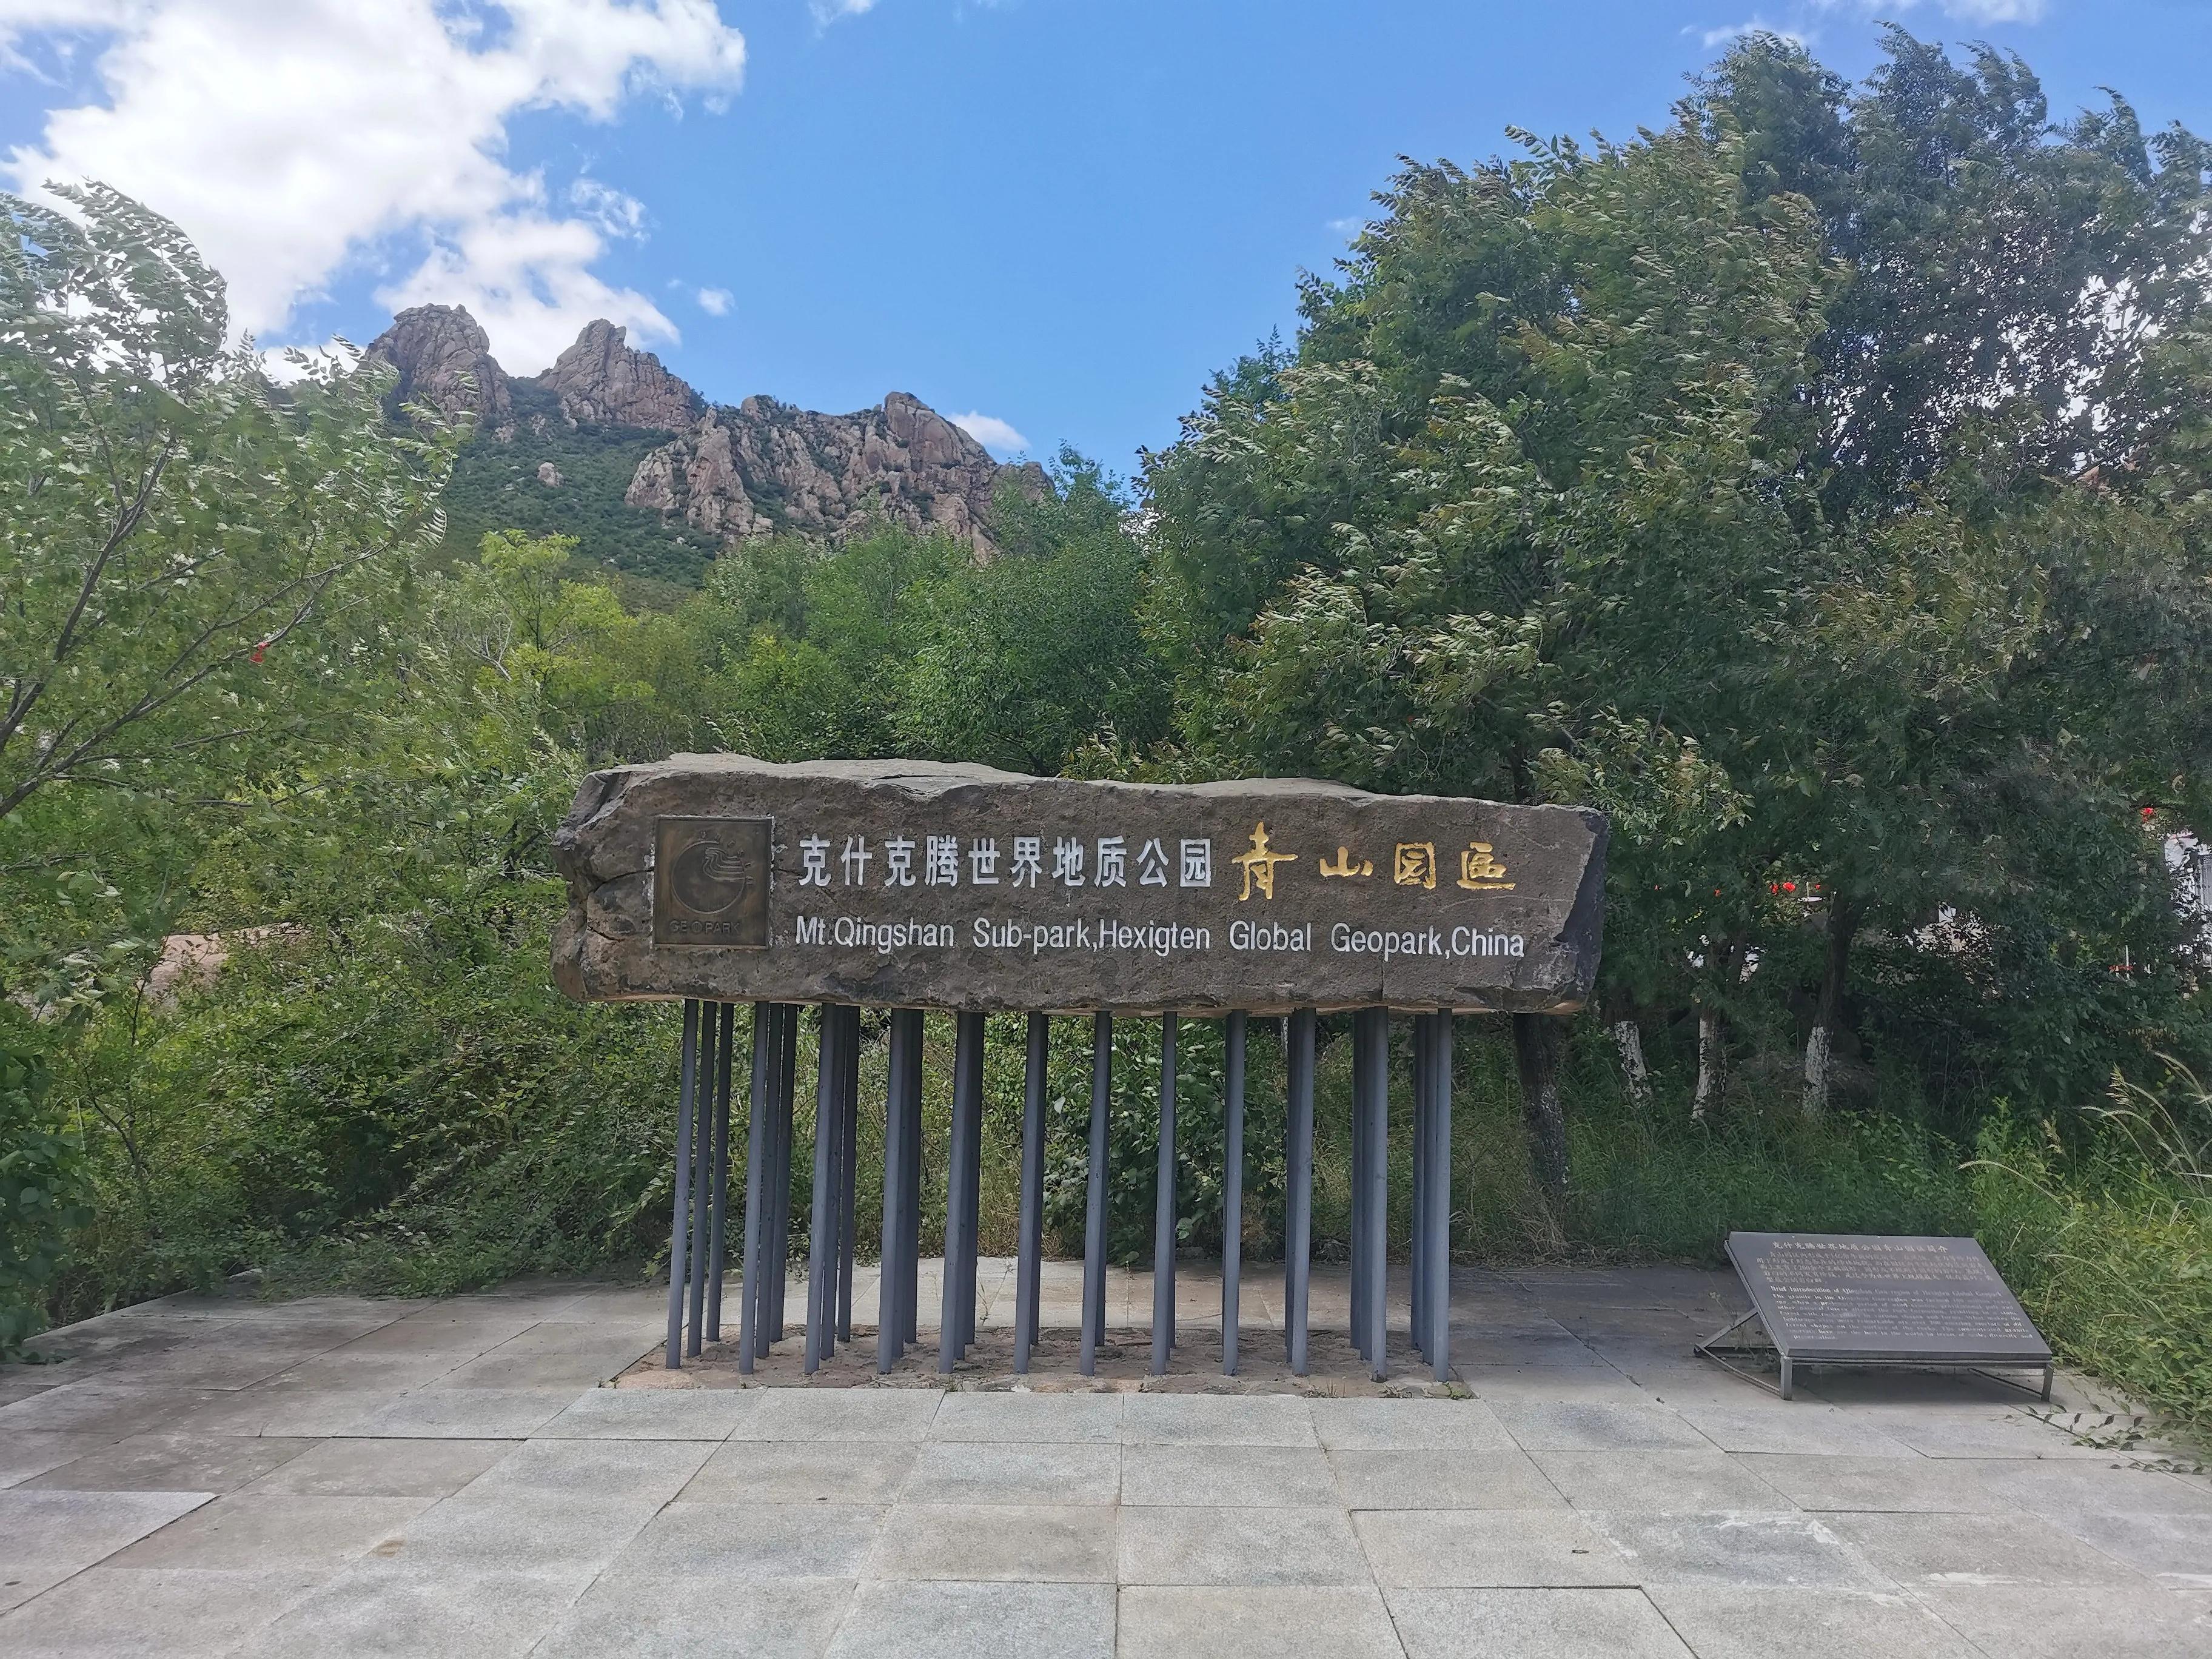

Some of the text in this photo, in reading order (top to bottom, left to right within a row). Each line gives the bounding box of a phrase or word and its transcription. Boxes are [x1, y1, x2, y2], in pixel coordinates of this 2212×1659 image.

[799, 833, 1212, 888] 克什克腾世界地质公园
[796, 916, 1524, 962] Mt.Qingshan Sub-park,Hexigten Global Geopark,China
